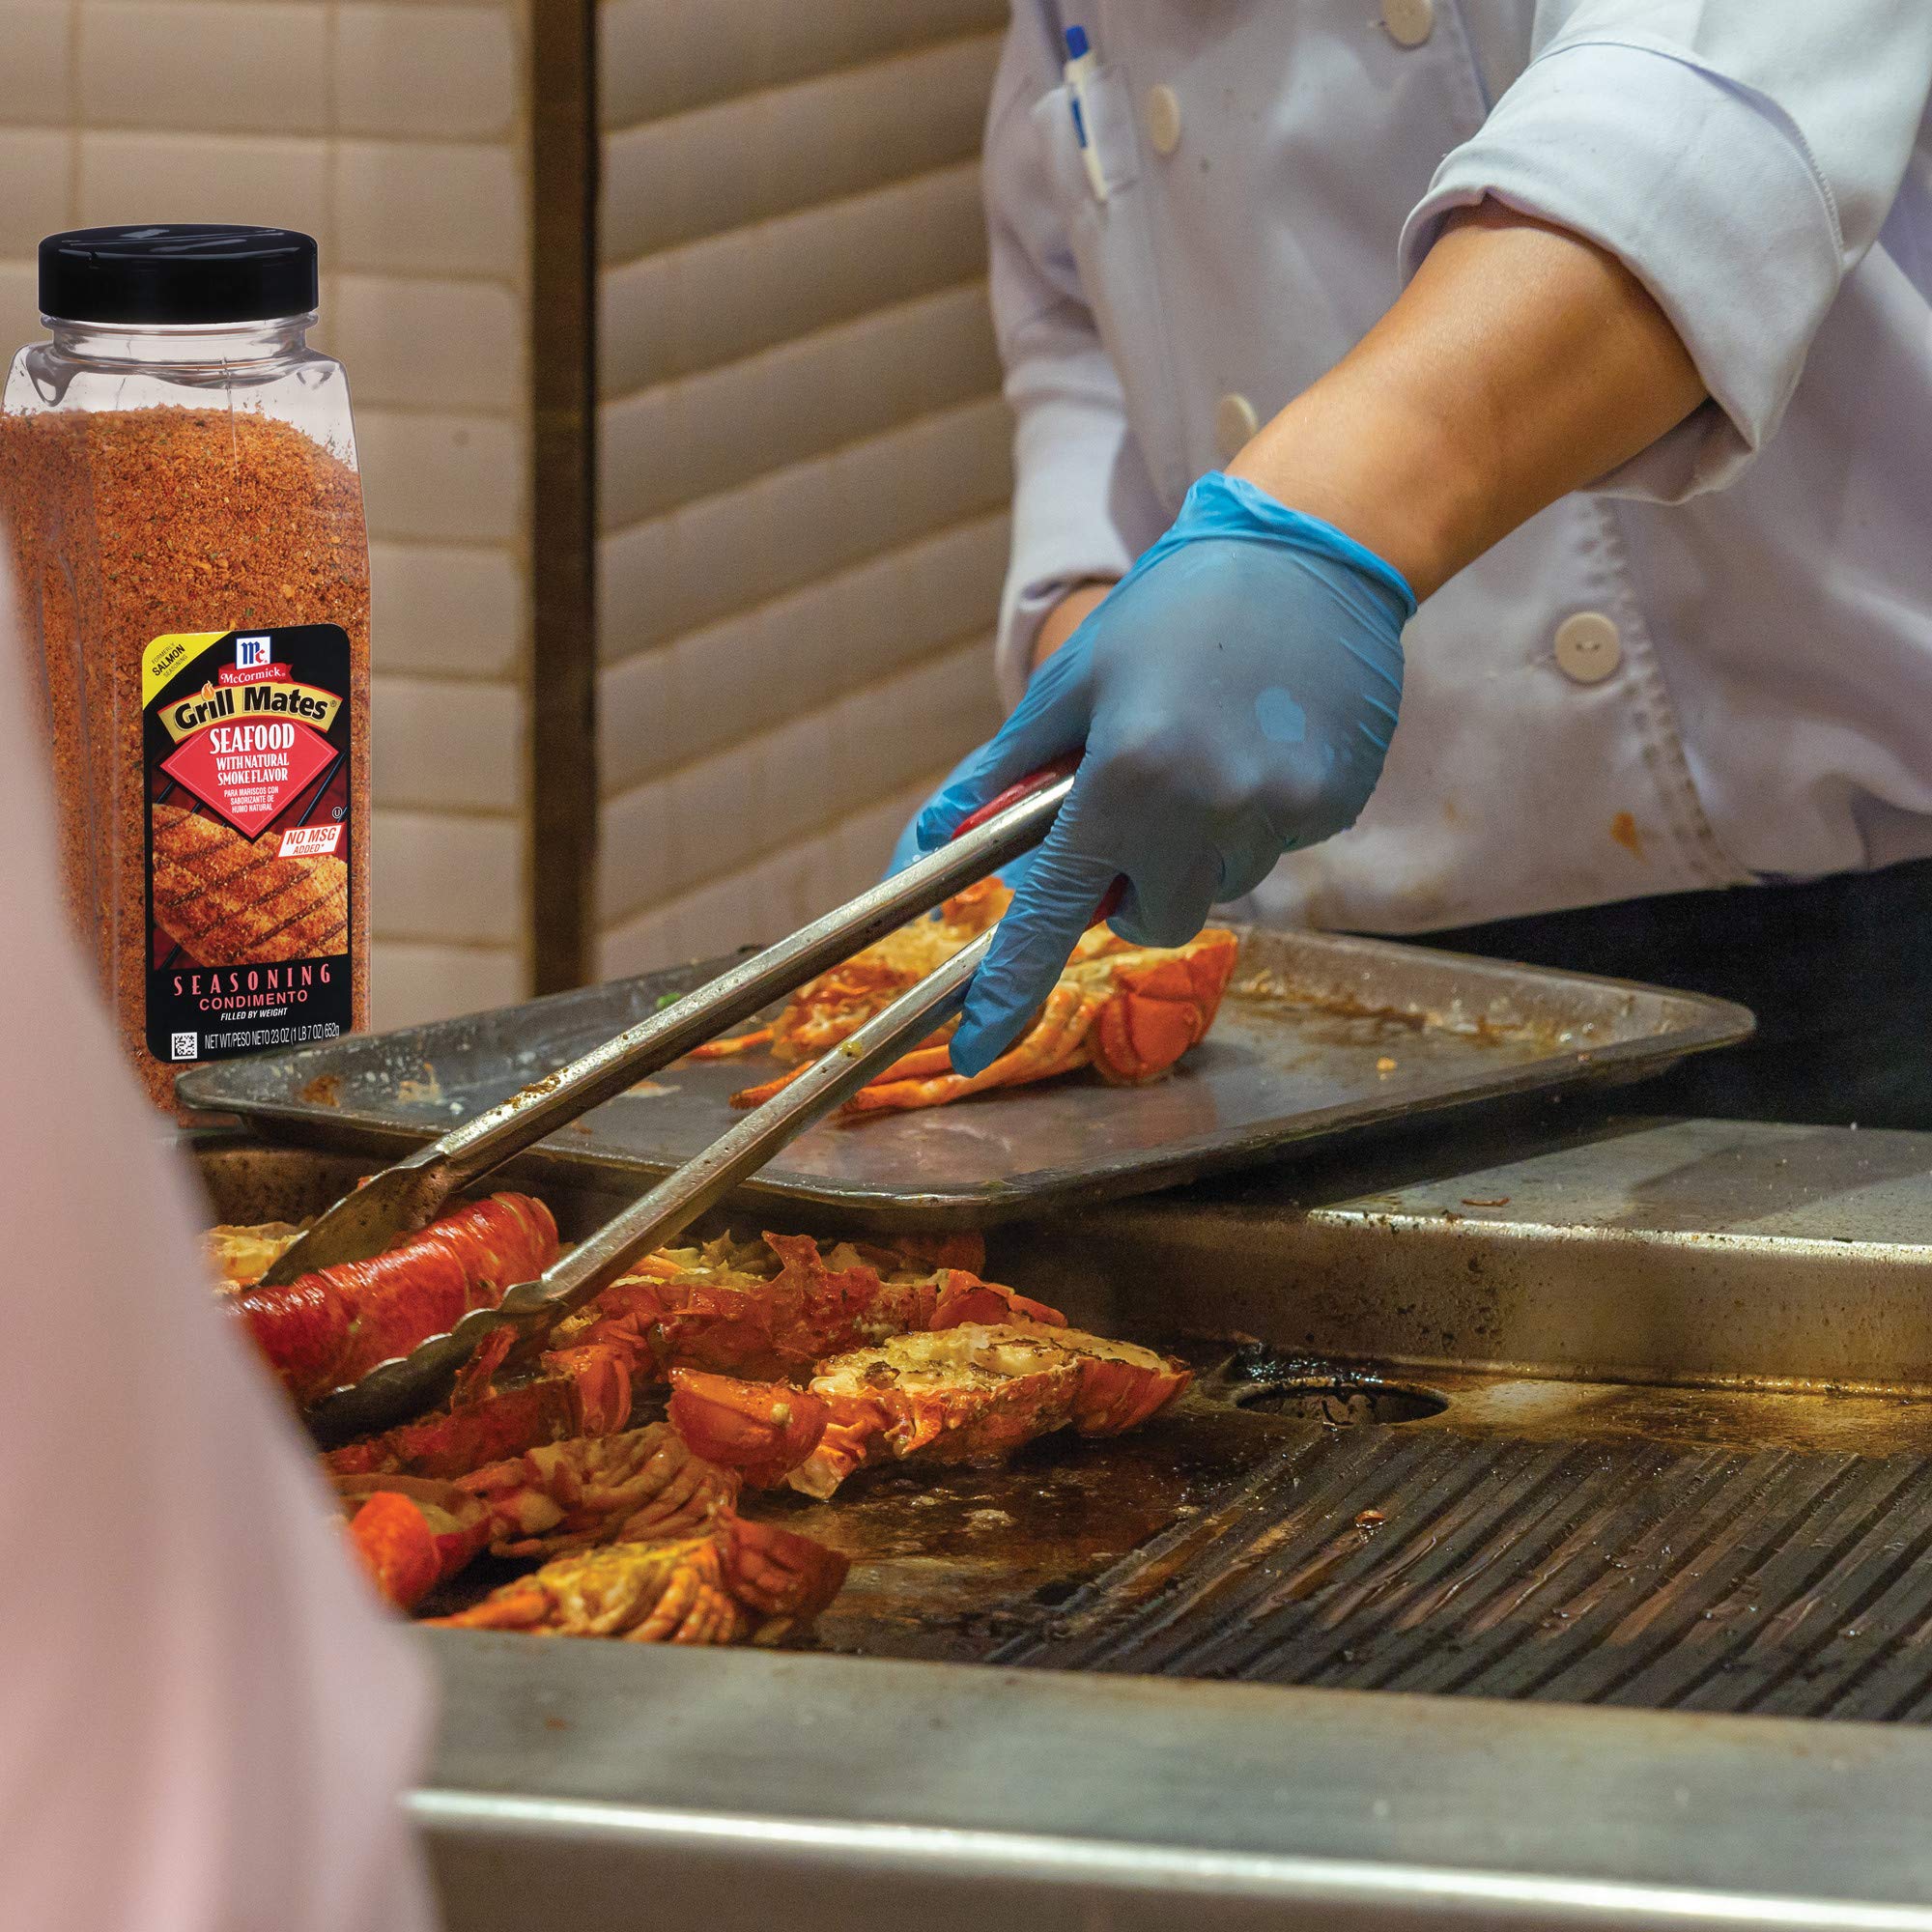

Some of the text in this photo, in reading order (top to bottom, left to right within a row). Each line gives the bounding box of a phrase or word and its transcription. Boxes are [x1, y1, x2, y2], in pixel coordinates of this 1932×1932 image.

[151, 641, 176, 665] FORMERLY
[152, 643, 185, 676] SALMON
[163, 654, 188, 678] SEASONING
[220, 668, 280, 684] McCormick
[175, 686, 329, 730] Grill Mates
[210, 724, 295, 753] SEAFOOD
[216, 753, 289, 771] WITH NATURAL
[217, 768, 288, 786] SMOKE FLAVOR
[223, 788, 238, 797] PARA
[239, 787, 267, 796] MARISCOS
[230, 795, 266, 805] SABORIZANTE
[232, 804, 273, 813] HUMO NATURAL
[286, 827, 337, 845] NO MSG
[174, 963, 330, 996] SEASONING
[199, 989, 308, 1011] CONDIMENTO
[220, 1008, 288, 1021] FILLED BY WEIGHT
[205, 1034, 218, 1050] NET
[251, 1030, 270, 1046] NETO
[270, 1029, 280, 1044] 23
[280, 1028, 290, 1043] OZ
[290, 1027, 298, 1045] (1
[298, 1025, 307, 1041] LB
[307, 1024, 312, 1039] 7
[312, 1023, 324, 1041] OZ)
